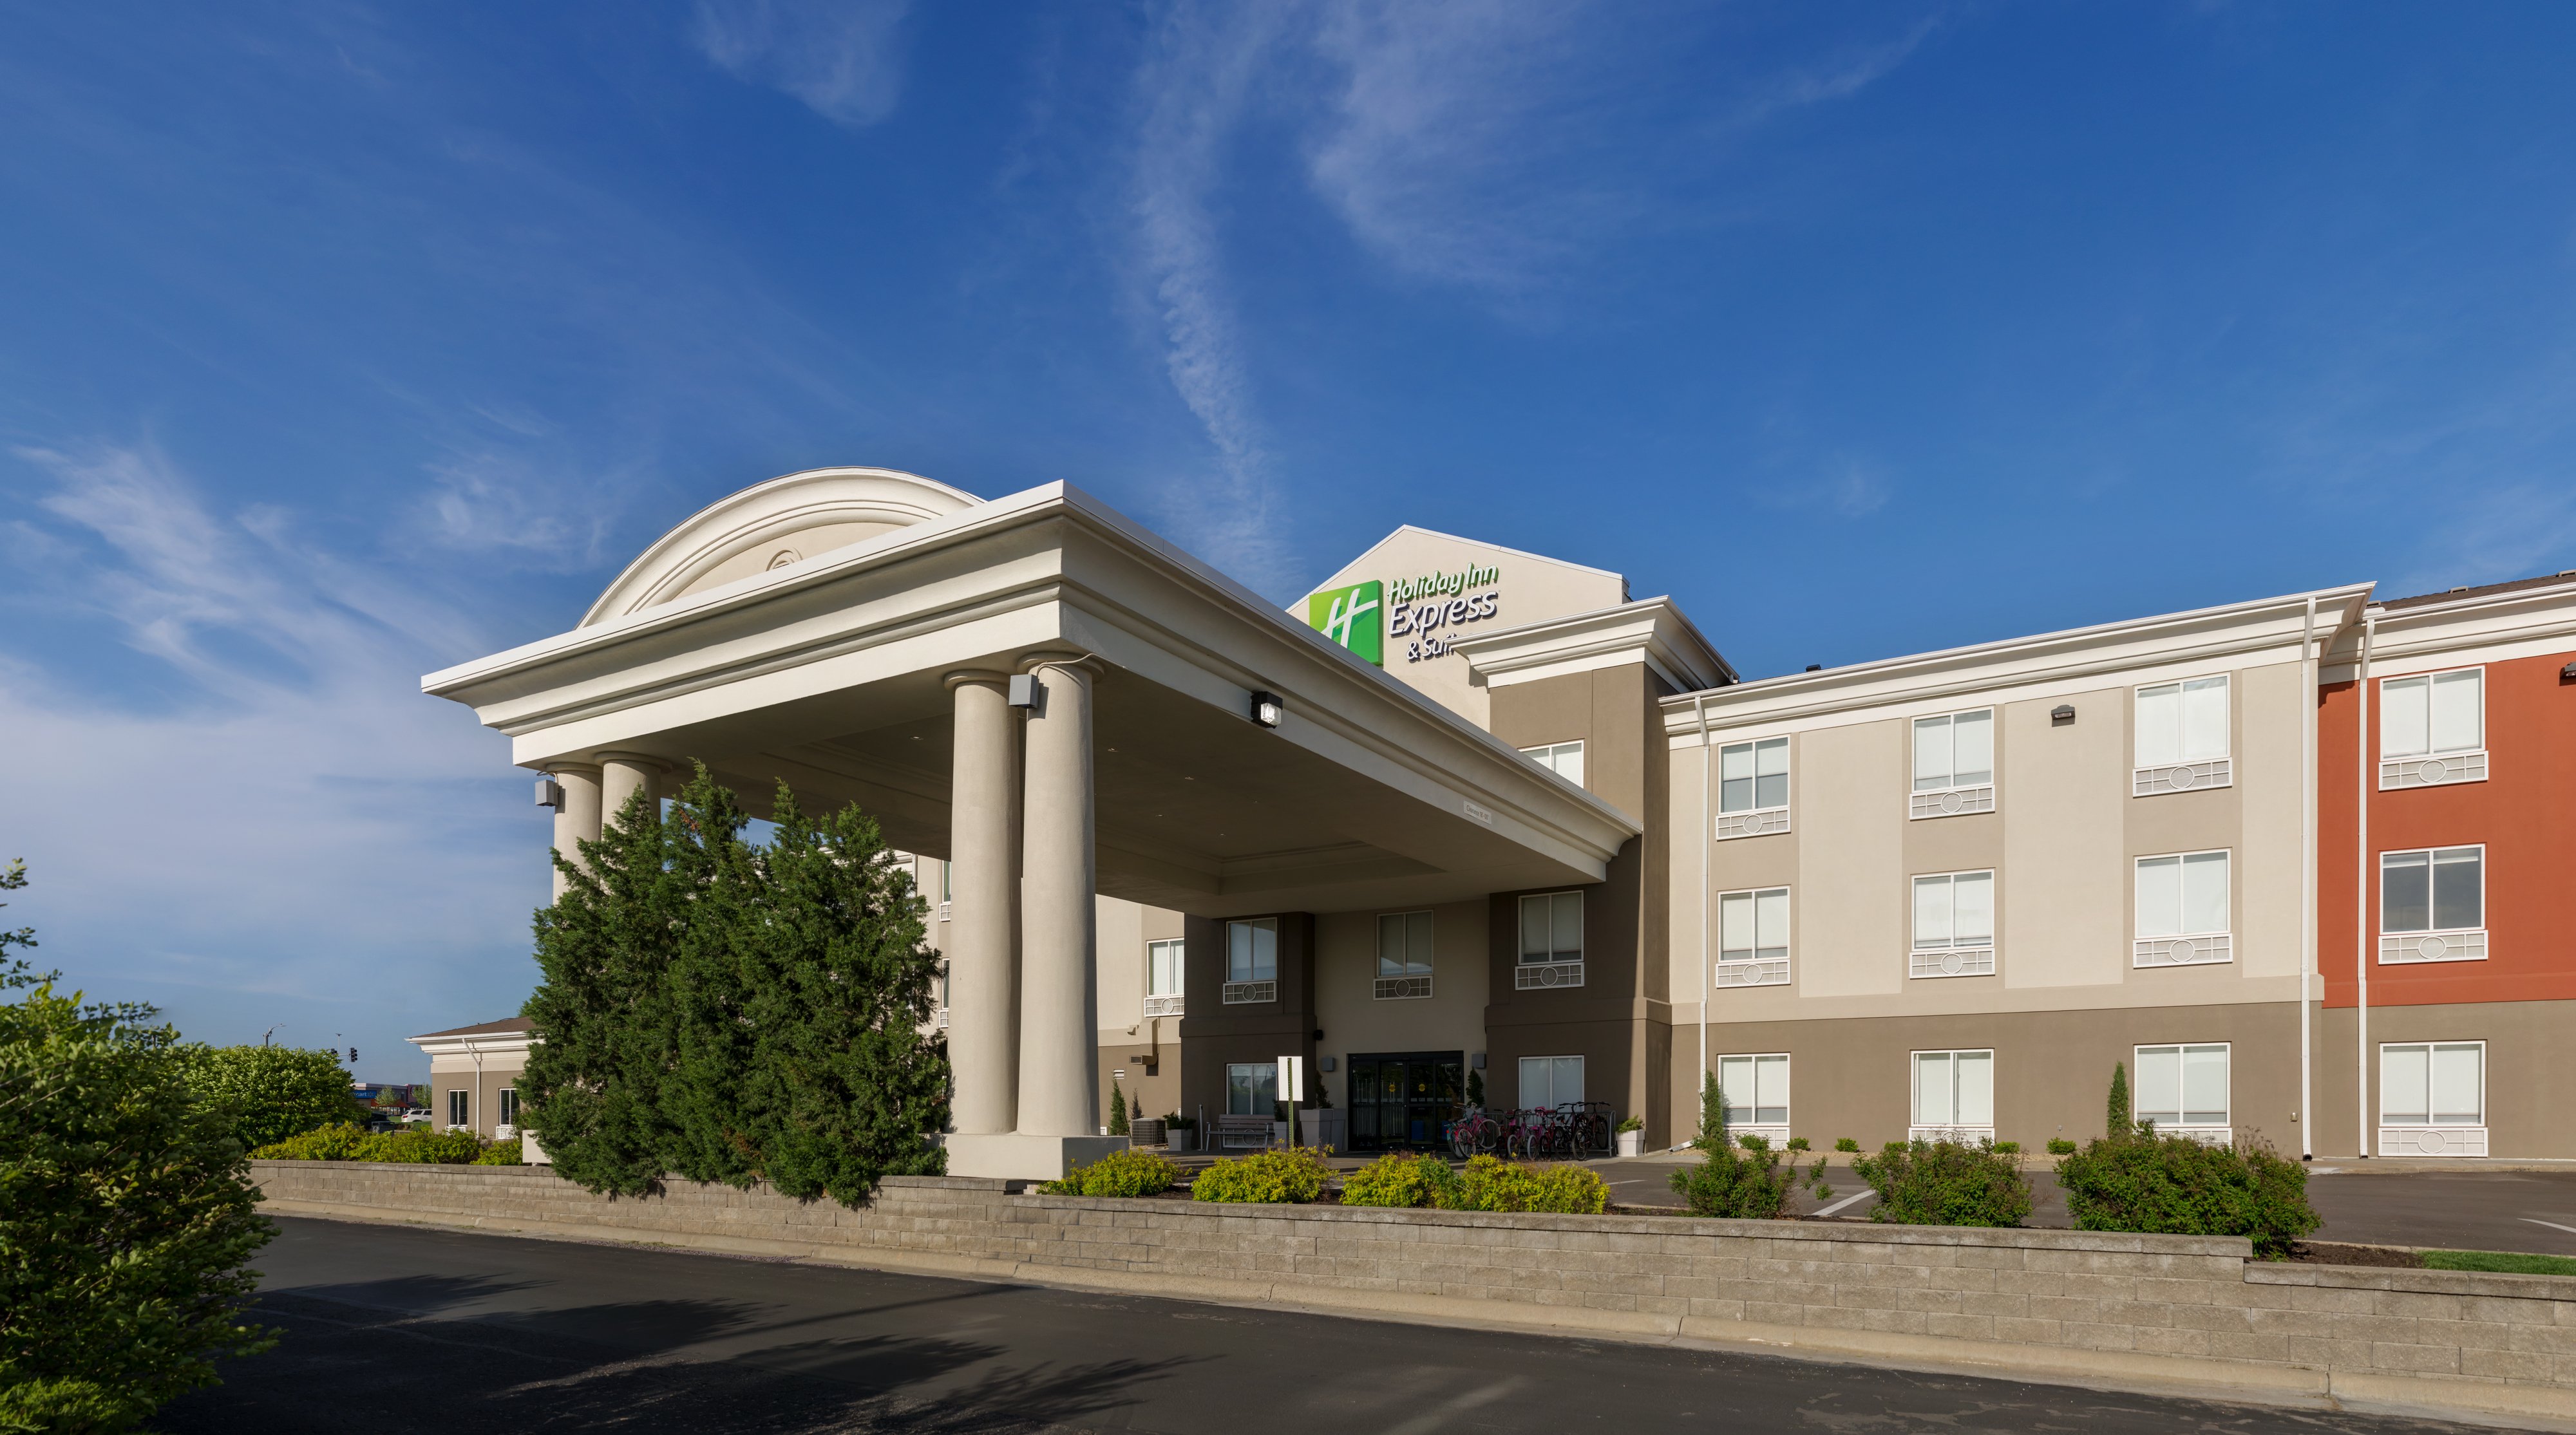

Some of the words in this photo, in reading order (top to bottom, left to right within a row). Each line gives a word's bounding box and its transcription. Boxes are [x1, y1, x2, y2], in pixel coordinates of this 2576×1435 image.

[1387, 570, 1464, 603] Holiday
[1465, 562, 1499, 586] Inn
[1388, 591, 1497, 637] Express
[1406, 641, 1421, 661] &
[1422, 633, 1456, 657] Suit
